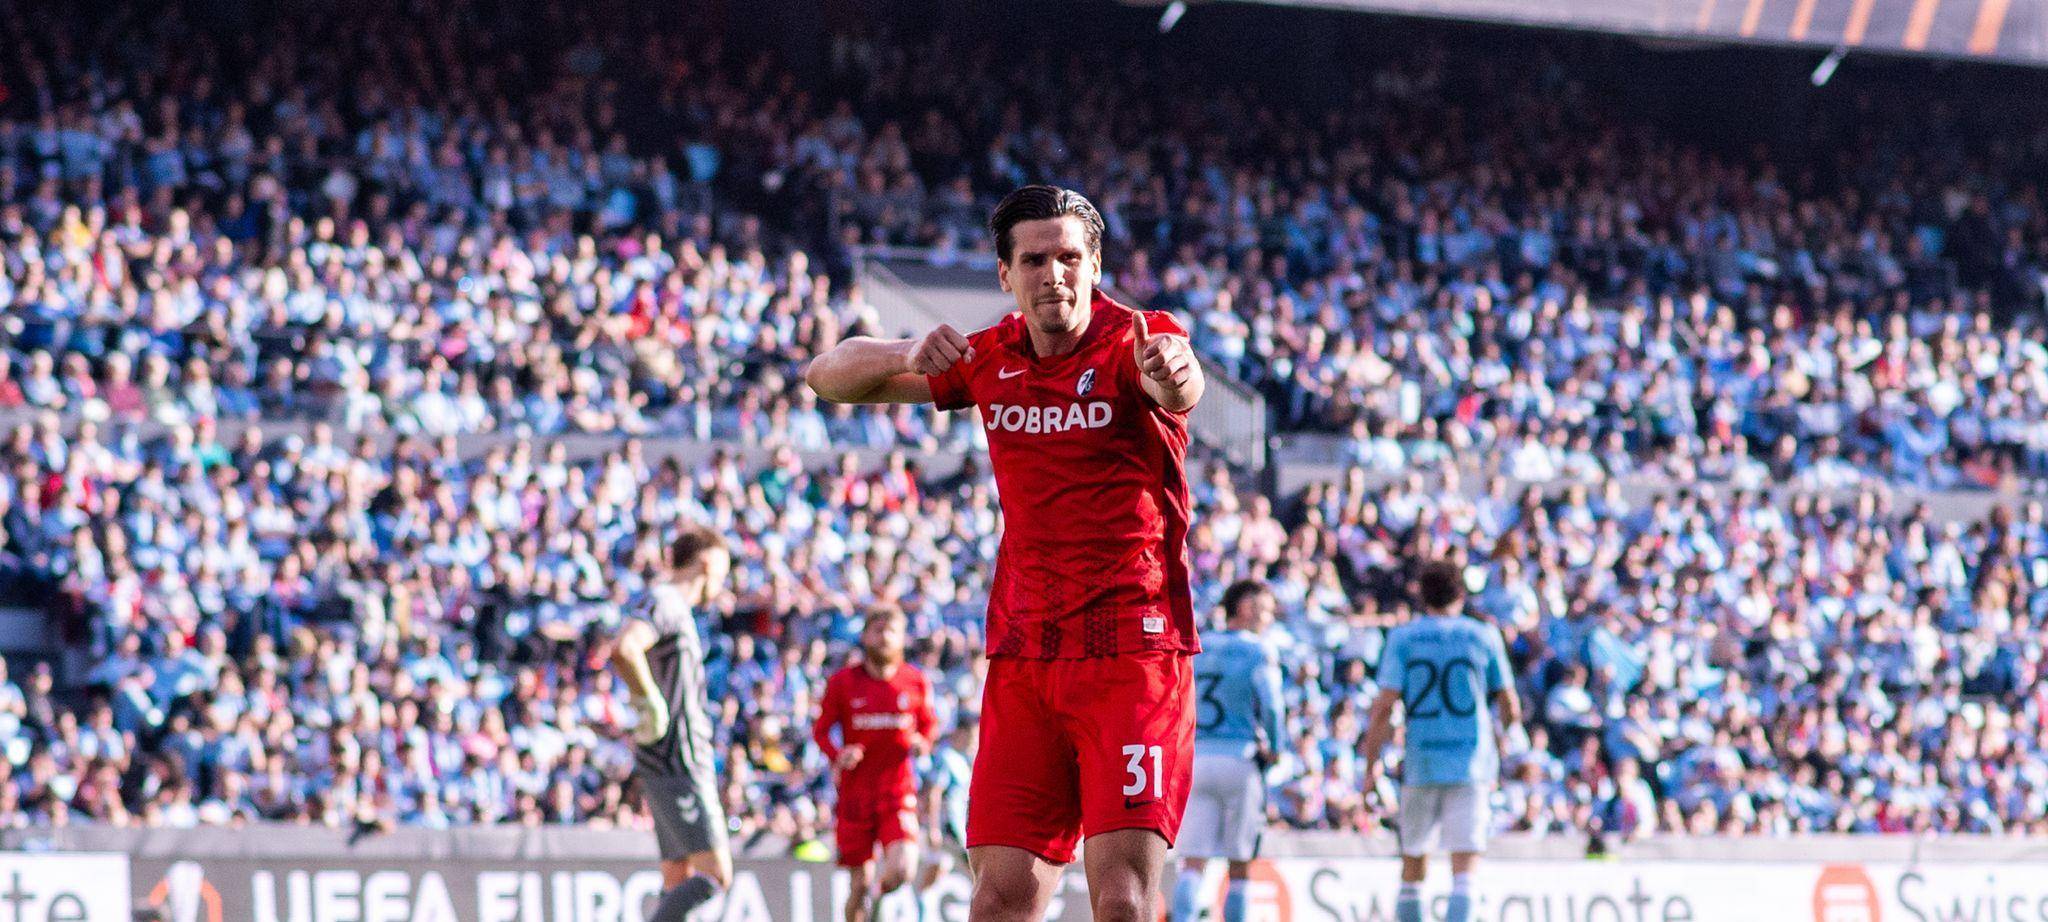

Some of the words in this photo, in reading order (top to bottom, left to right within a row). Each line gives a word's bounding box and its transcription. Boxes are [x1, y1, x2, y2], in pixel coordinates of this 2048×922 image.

[987, 401, 1112, 434] JOBRAD
[1406, 657, 1476, 719] 20
[1122, 744, 1163, 798] 31
[252, 869, 460, 922] UEFA
